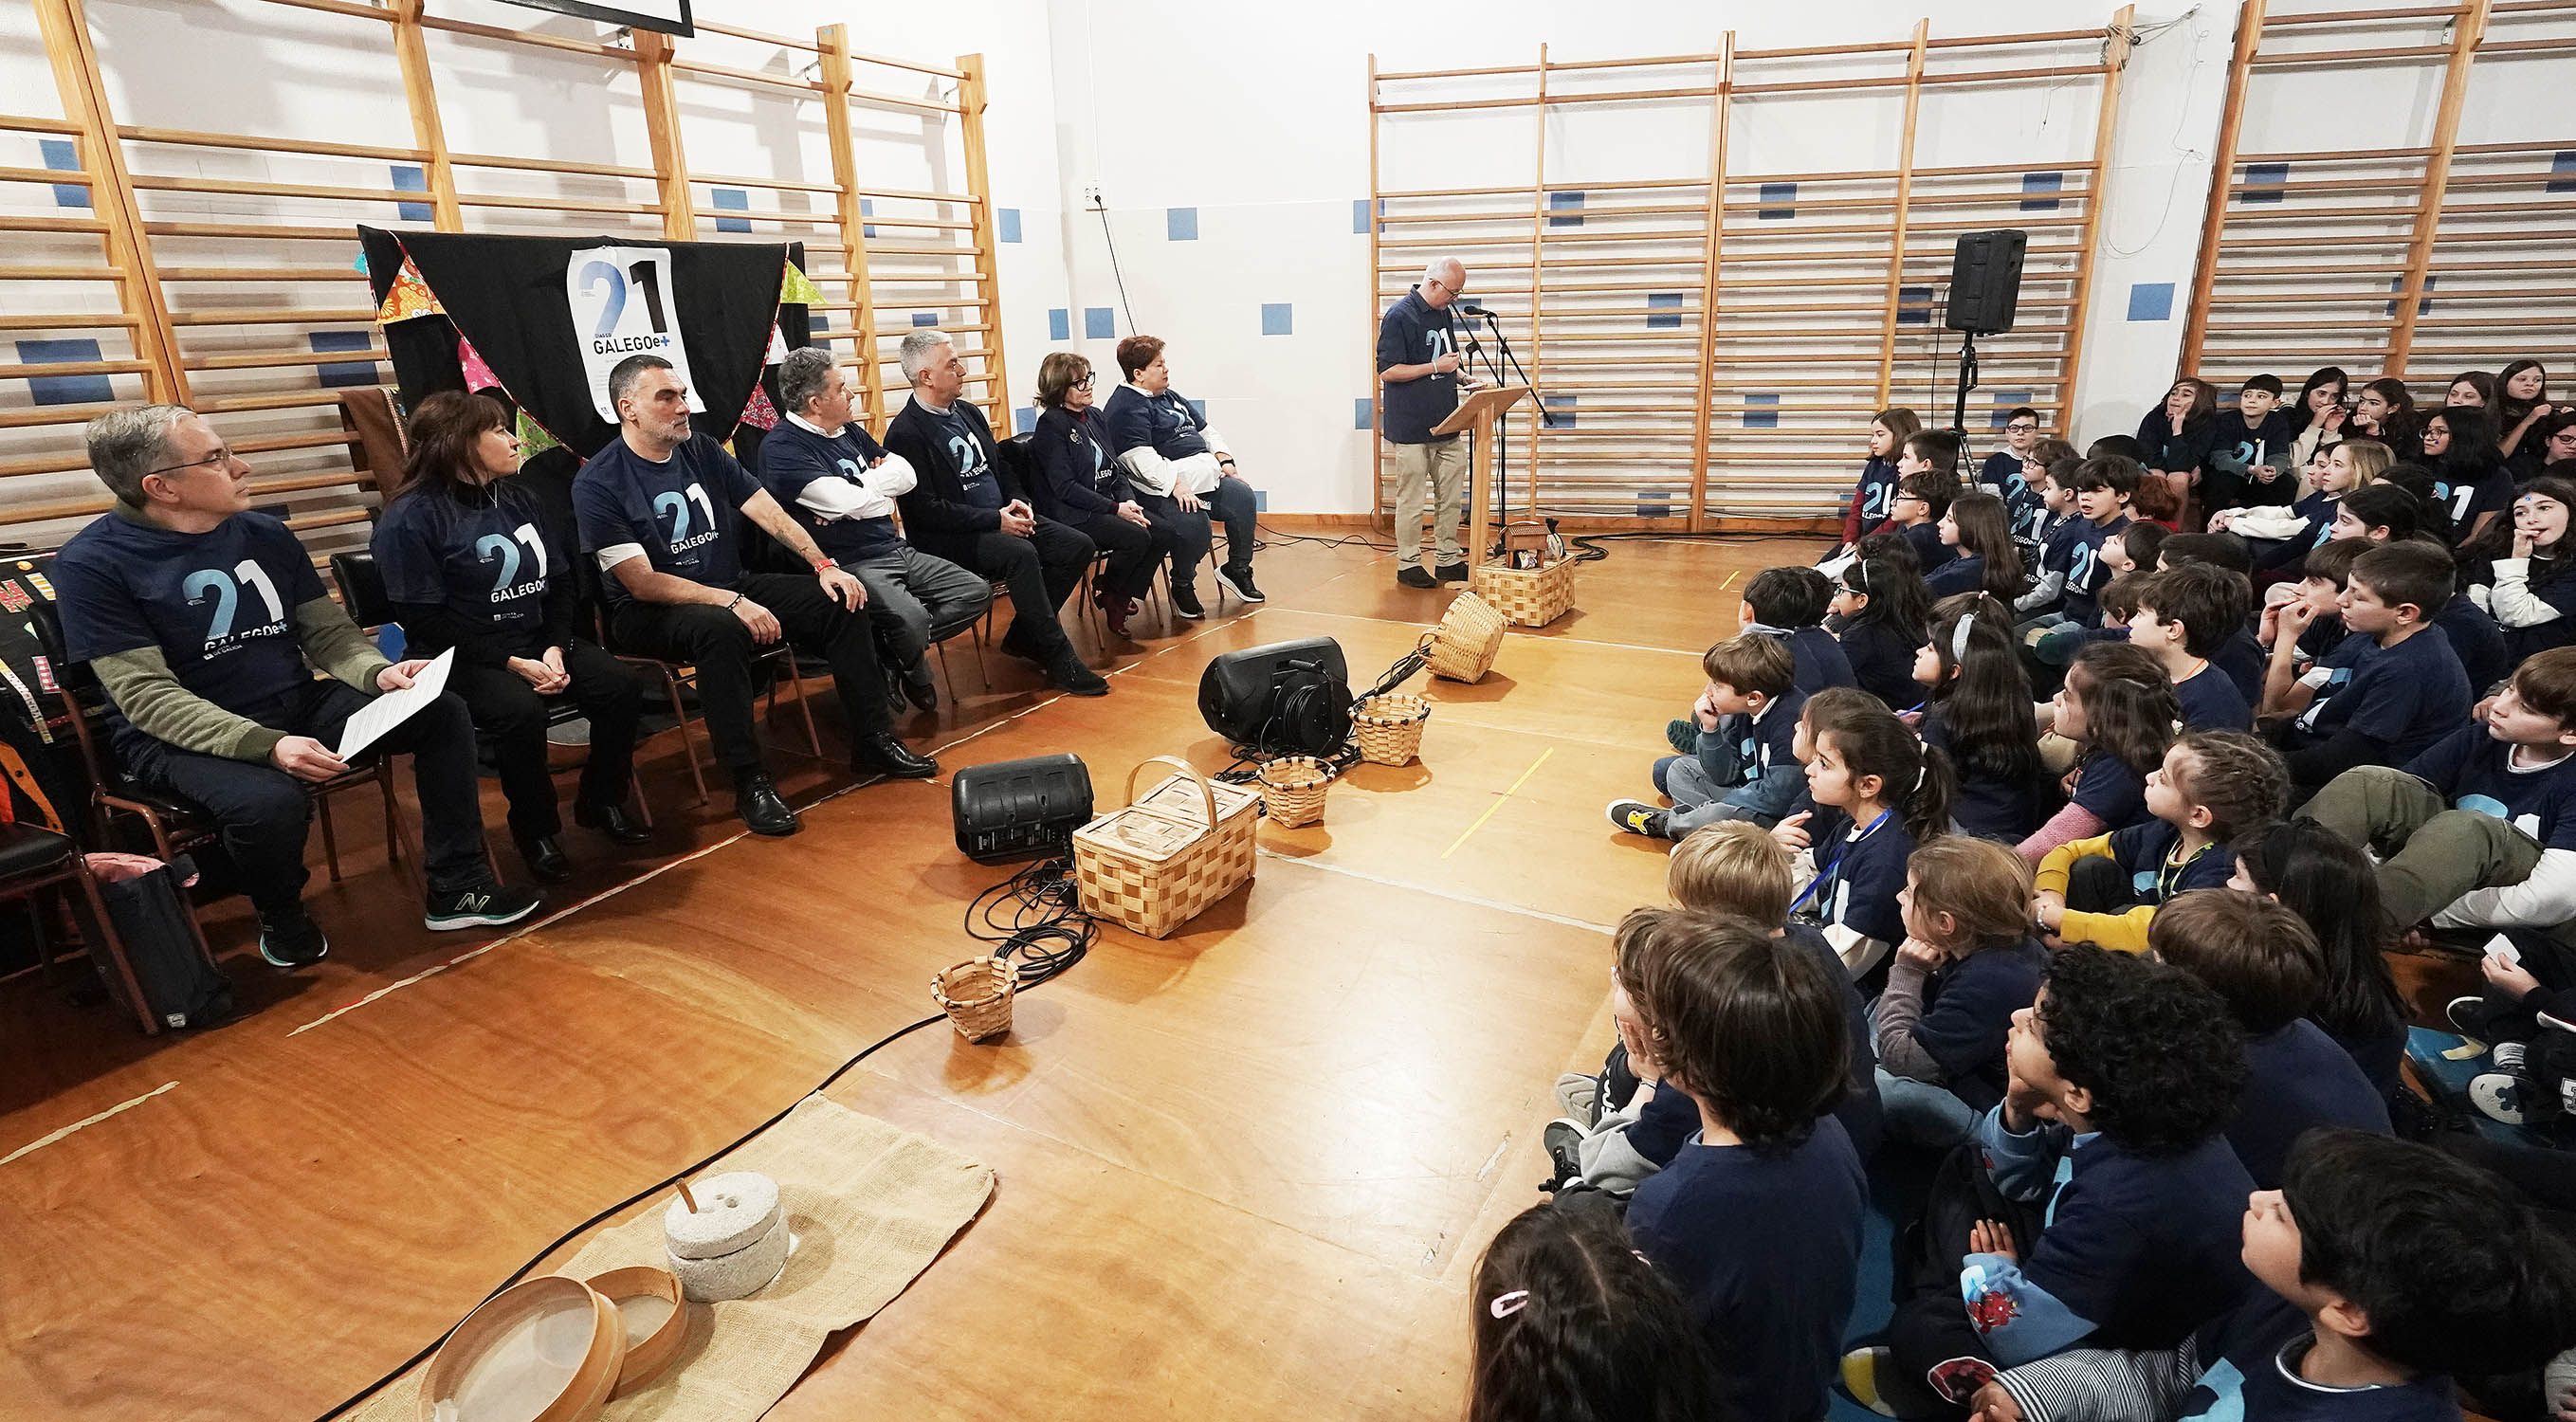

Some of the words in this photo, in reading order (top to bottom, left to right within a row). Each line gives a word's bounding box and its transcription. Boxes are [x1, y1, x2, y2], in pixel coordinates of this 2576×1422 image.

[578, 261, 668, 334] 21
[1426, 328, 1452, 360] 21
[949, 431, 986, 473] 21
[653, 483, 715, 544] 21
[1862, 482, 1893, 514] 21
[475, 522, 547, 592] 21
[2068, 541, 2097, 590] 21
[182, 558, 284, 641] 21
